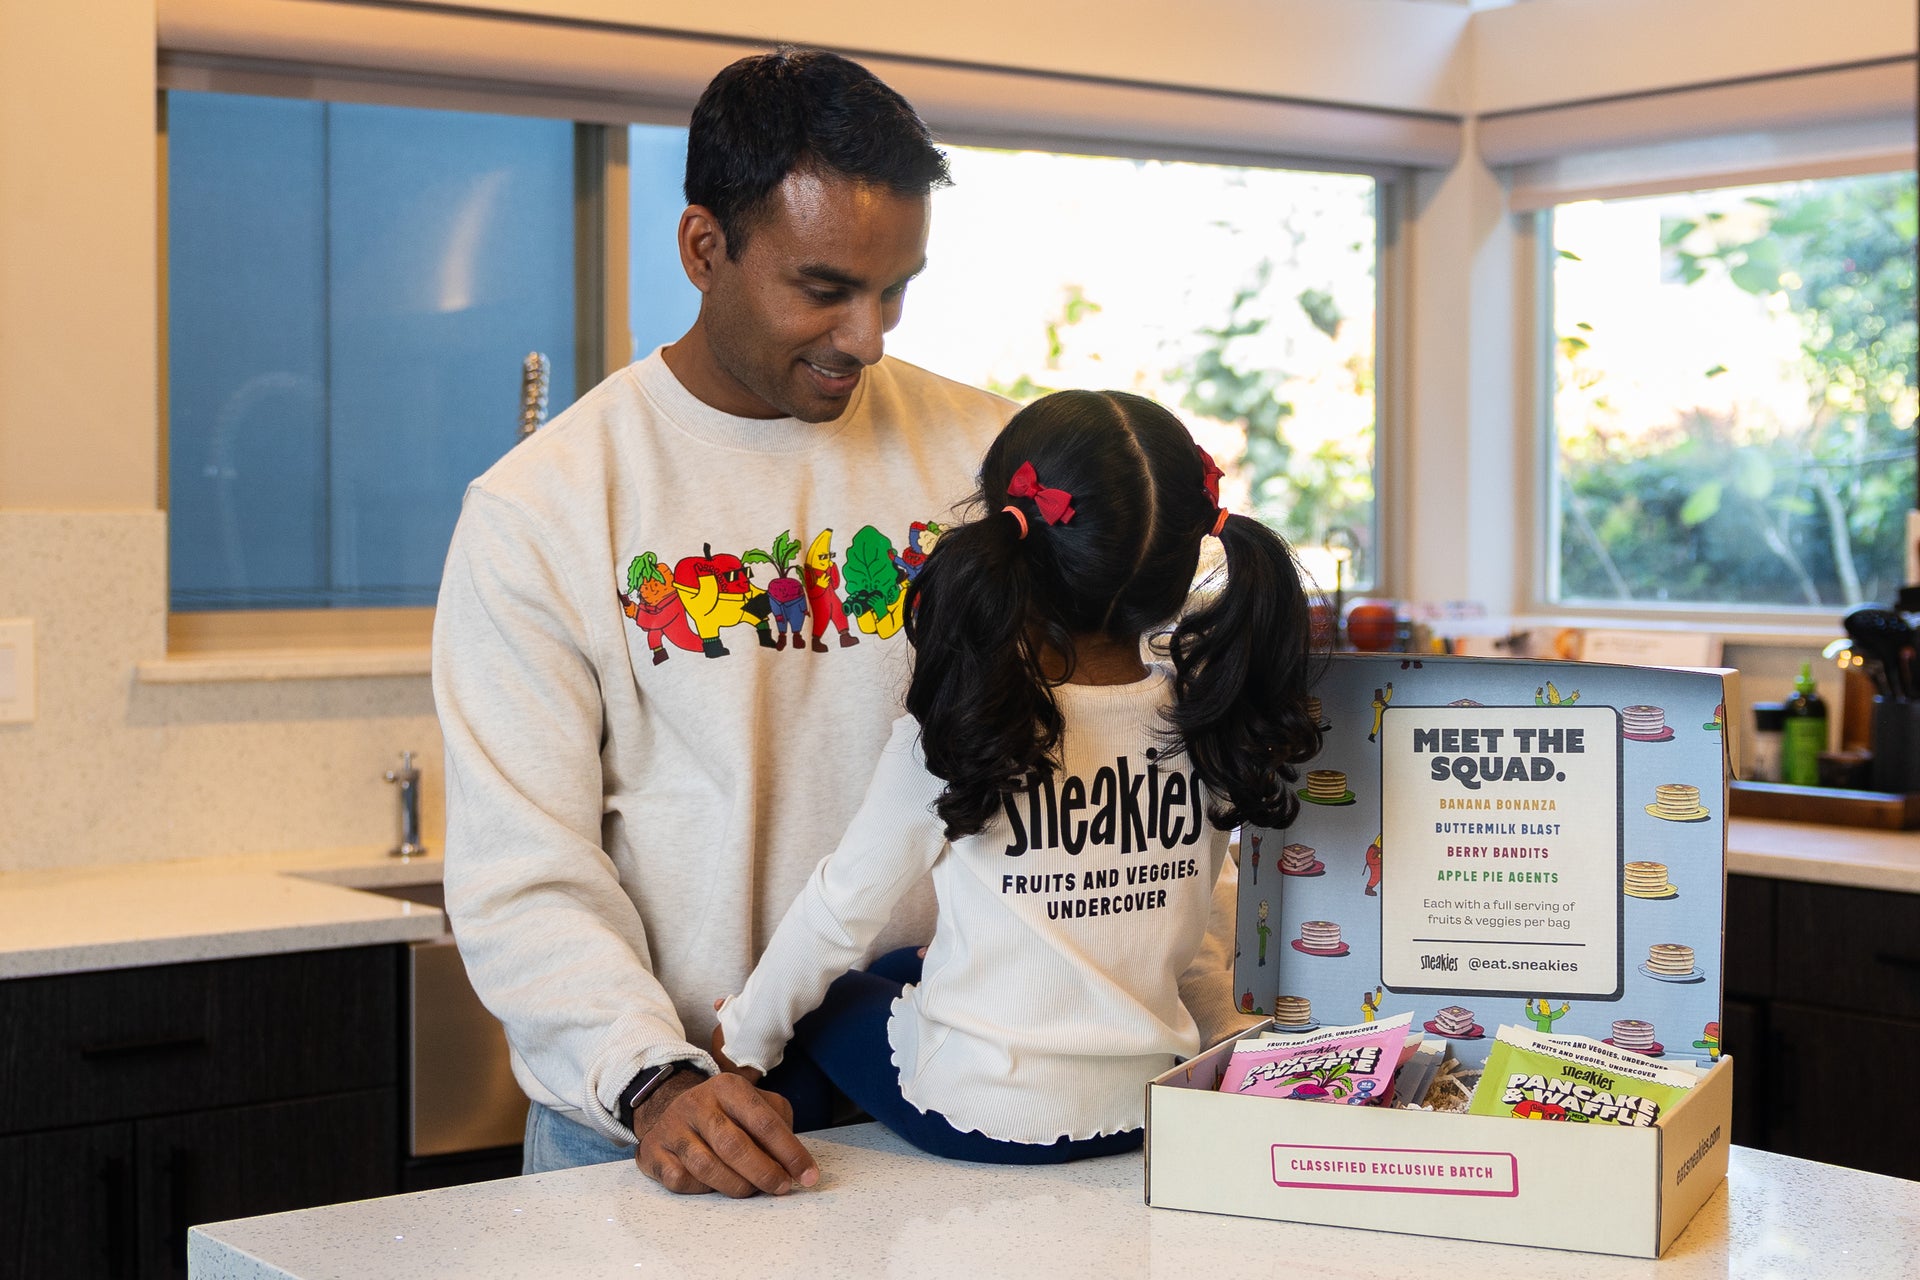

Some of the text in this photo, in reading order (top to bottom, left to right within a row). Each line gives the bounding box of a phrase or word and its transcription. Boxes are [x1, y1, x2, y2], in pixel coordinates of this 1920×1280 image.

[1413, 728, 1585, 754] MEET THE
[1431, 756, 1566, 790] SQUAD.
[1001, 747, 1202, 857] sneakies
[1439, 798, 1557, 812] BANANA BONANZA
[1435, 822, 1561, 836] BUTTERMILK BLAST
[1447, 846, 1549, 859] BERRY BANDITS
[1002, 858, 1200, 895] FRUITS AND VEGGIES,
[1437, 870, 1559, 884] APPLE PIE AGENTS
[1047, 889, 1168, 921] UNDERCOVER
[1423, 898, 1576, 913] Each with a full serving of
[1428, 914, 1571, 930] fruits & veggies per bag
[1420, 953, 1578, 972] sneakies @eat.sneakies
[1266, 1040, 1291, 1048] FRUITS
[1335, 1025, 1379, 1037] UNDERCOVER
[1245, 1046, 1381, 1080] PANCAKE
[1531, 1041, 1657, 1079] FRUITS AND VEGGIES, UNDERCOVER
[1572, 1041, 1587, 1050] AND
[1588, 1044, 1620, 1060] VEGGIES,
[1560, 1065, 1615, 1090] sneakies
[1501, 1087, 1656, 1127] & WAFFLE
[1507, 1073, 1659, 1117] PANCAKE
[1676, 1124, 1721, 1187] eatsneakies.com
[1290, 1159, 1494, 1179] CLASSIFIED EXCLUSIVE BATCH
